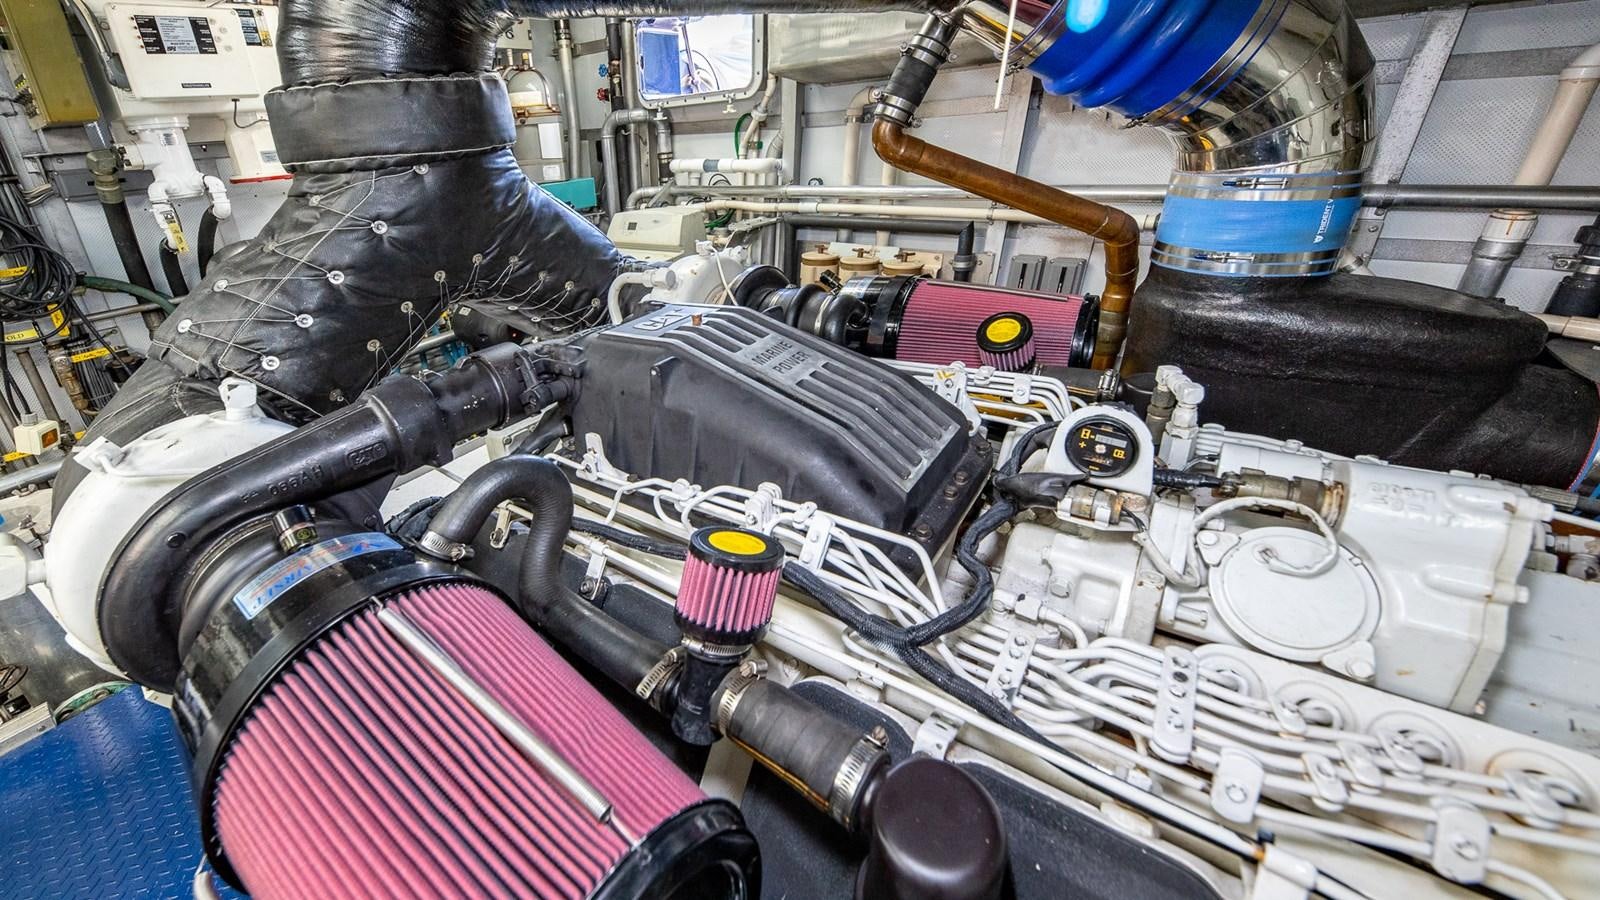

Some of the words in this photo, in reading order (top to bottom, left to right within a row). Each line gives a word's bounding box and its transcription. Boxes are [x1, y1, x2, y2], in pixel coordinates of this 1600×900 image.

[1316, 203, 1331, 234] TRIDENT
[751, 340, 792, 366] MARINE
[771, 350, 809, 374] POWER
